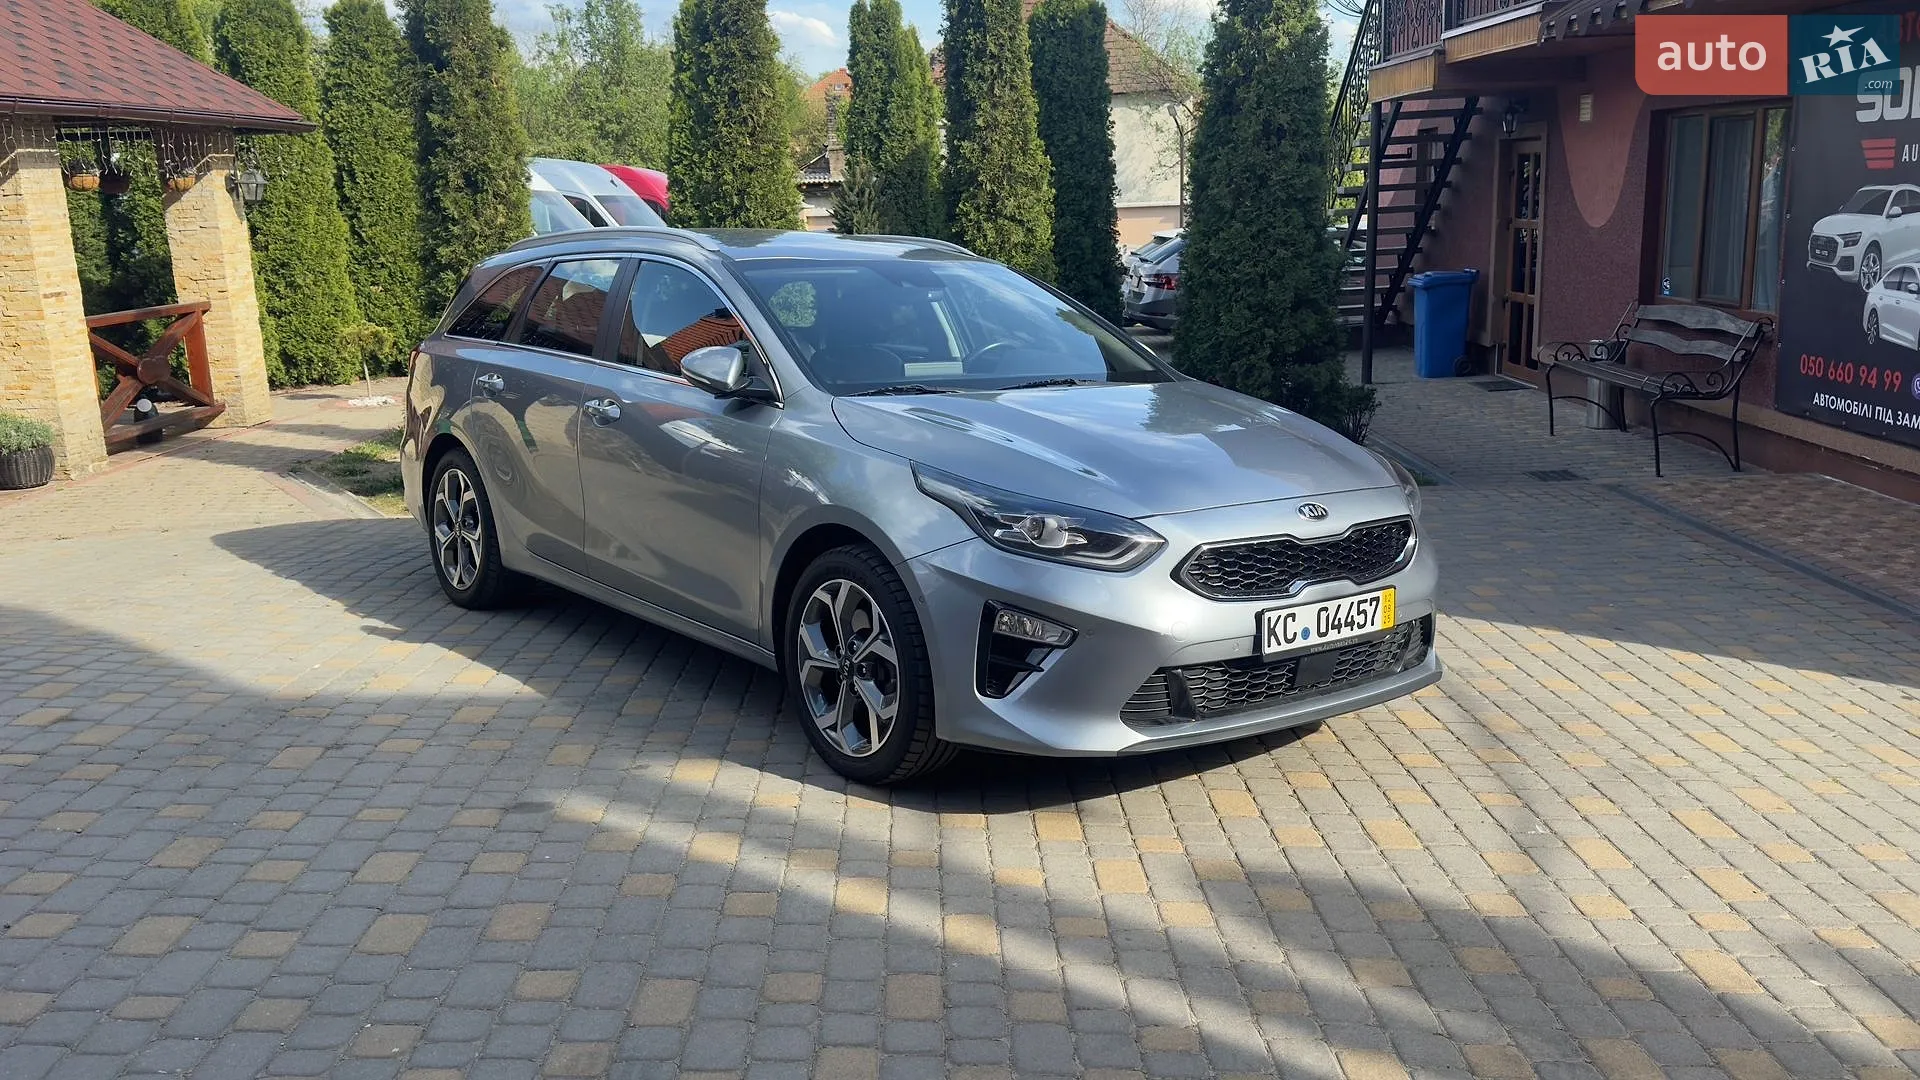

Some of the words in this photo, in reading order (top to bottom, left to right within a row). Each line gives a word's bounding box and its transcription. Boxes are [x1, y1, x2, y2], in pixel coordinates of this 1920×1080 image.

[1800, 354, 1824, 377] 050
[1828, 360, 1853, 384] 660
[1860, 365, 1878, 389] 94
[1884, 369, 1902, 393] 99
[1813, 392, 1872, 418] АВТОМОБІЛІ
[1875, 406, 1893, 425] ПІД
[1301, 505, 1326, 517] KIA
[1266, 612, 1298, 649] KC
[1317, 596, 1380, 638] 04457
